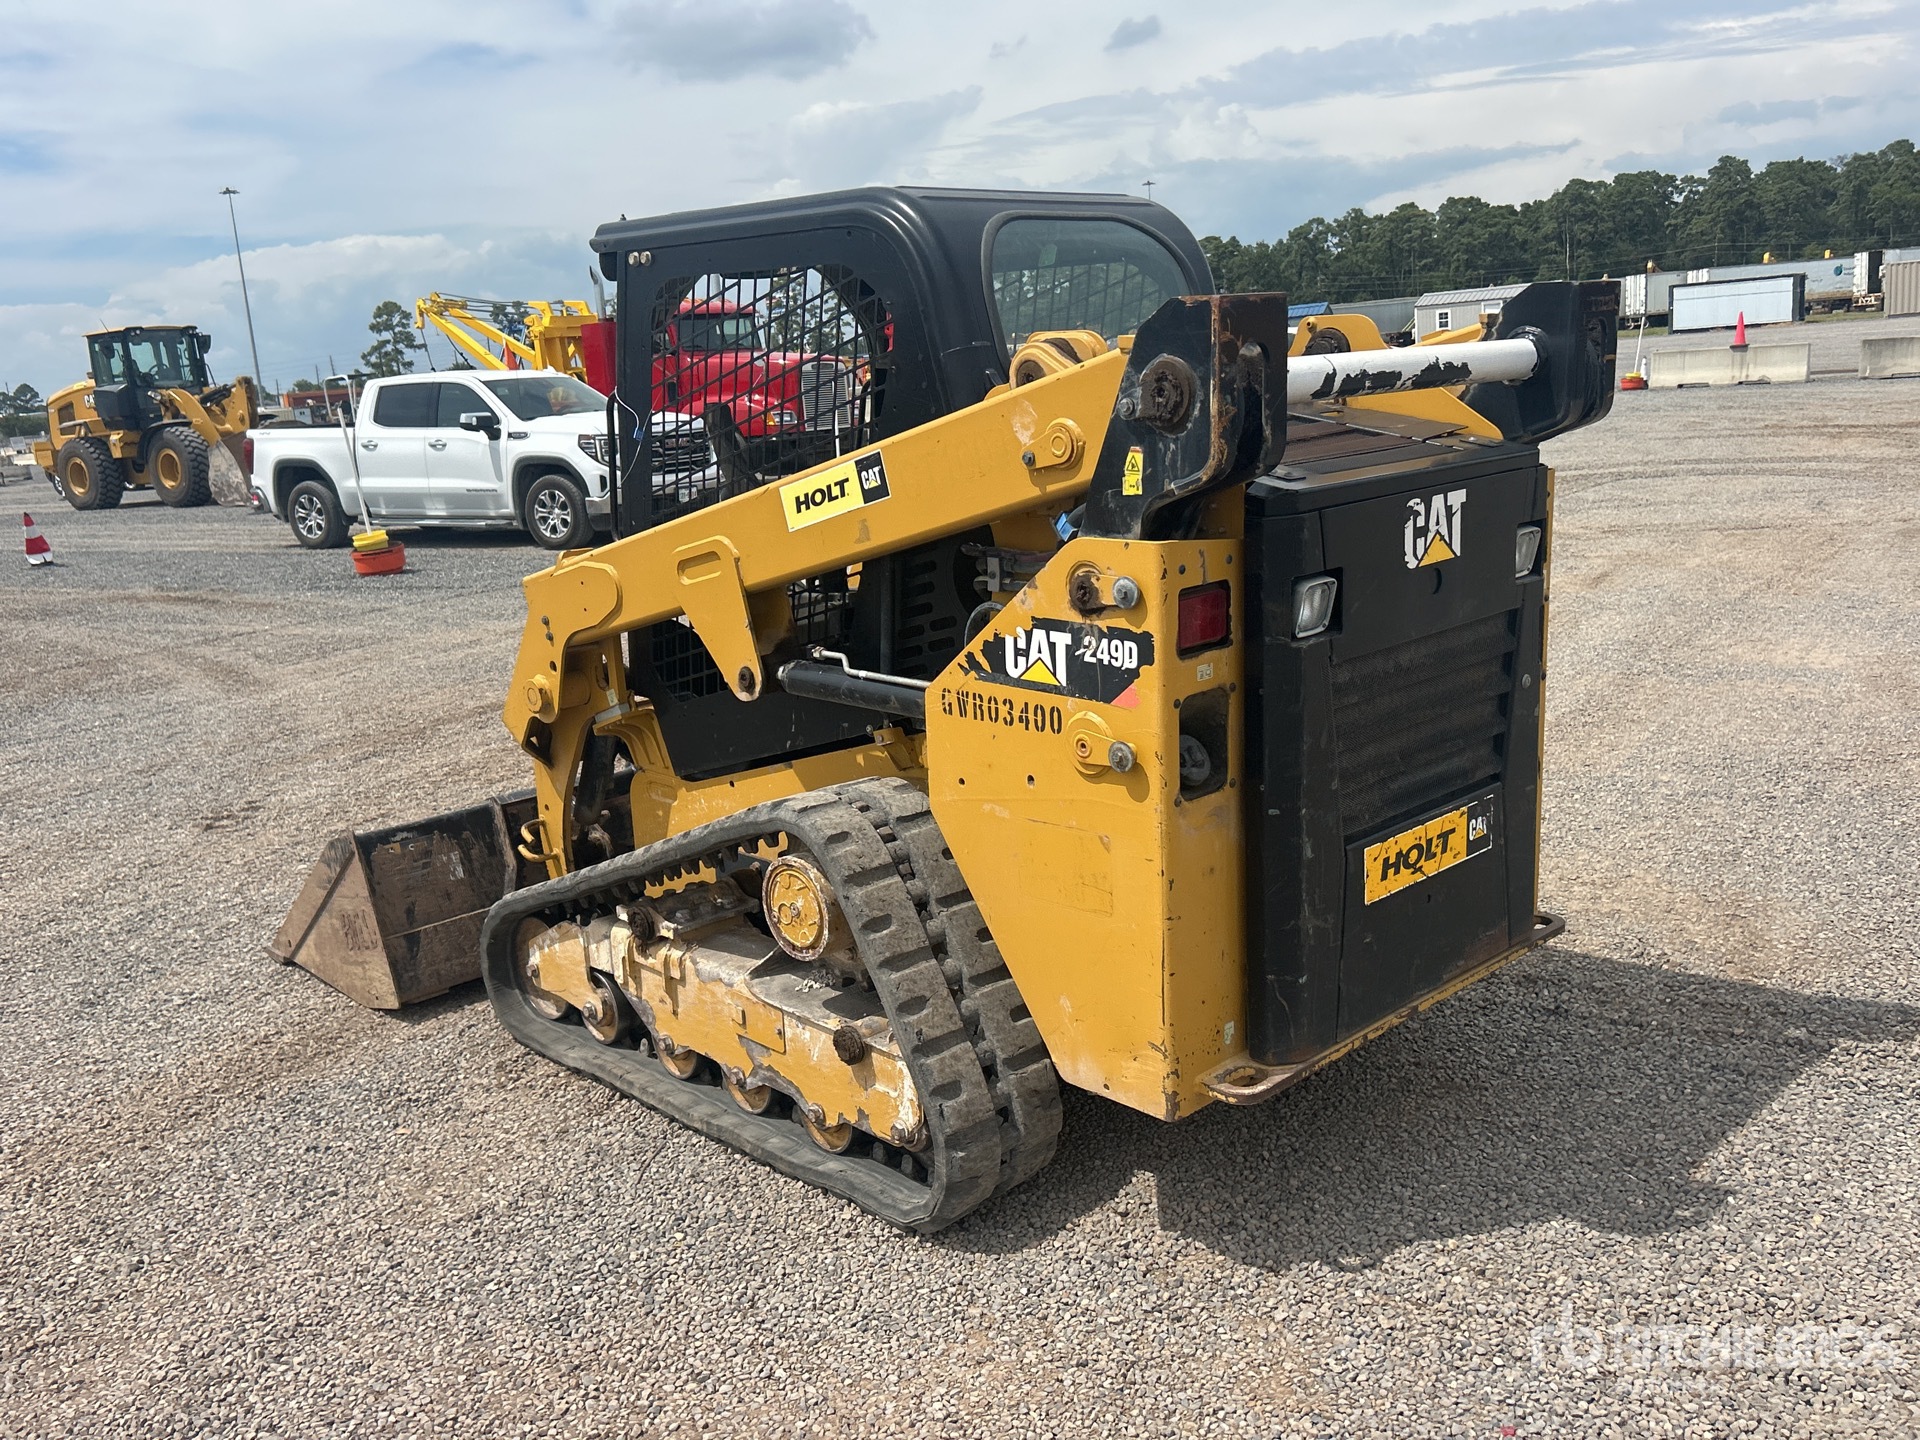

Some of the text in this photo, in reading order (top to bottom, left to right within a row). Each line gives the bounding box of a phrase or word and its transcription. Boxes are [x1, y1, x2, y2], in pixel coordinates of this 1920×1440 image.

[794, 465, 882, 514] HOLT CAT
[1404, 488, 1467, 569] CAT
[1005, 626, 1139, 687] CAT 249D
[941, 687, 1063, 735] GWR03400
[1380, 827, 1456, 882] HOLT
